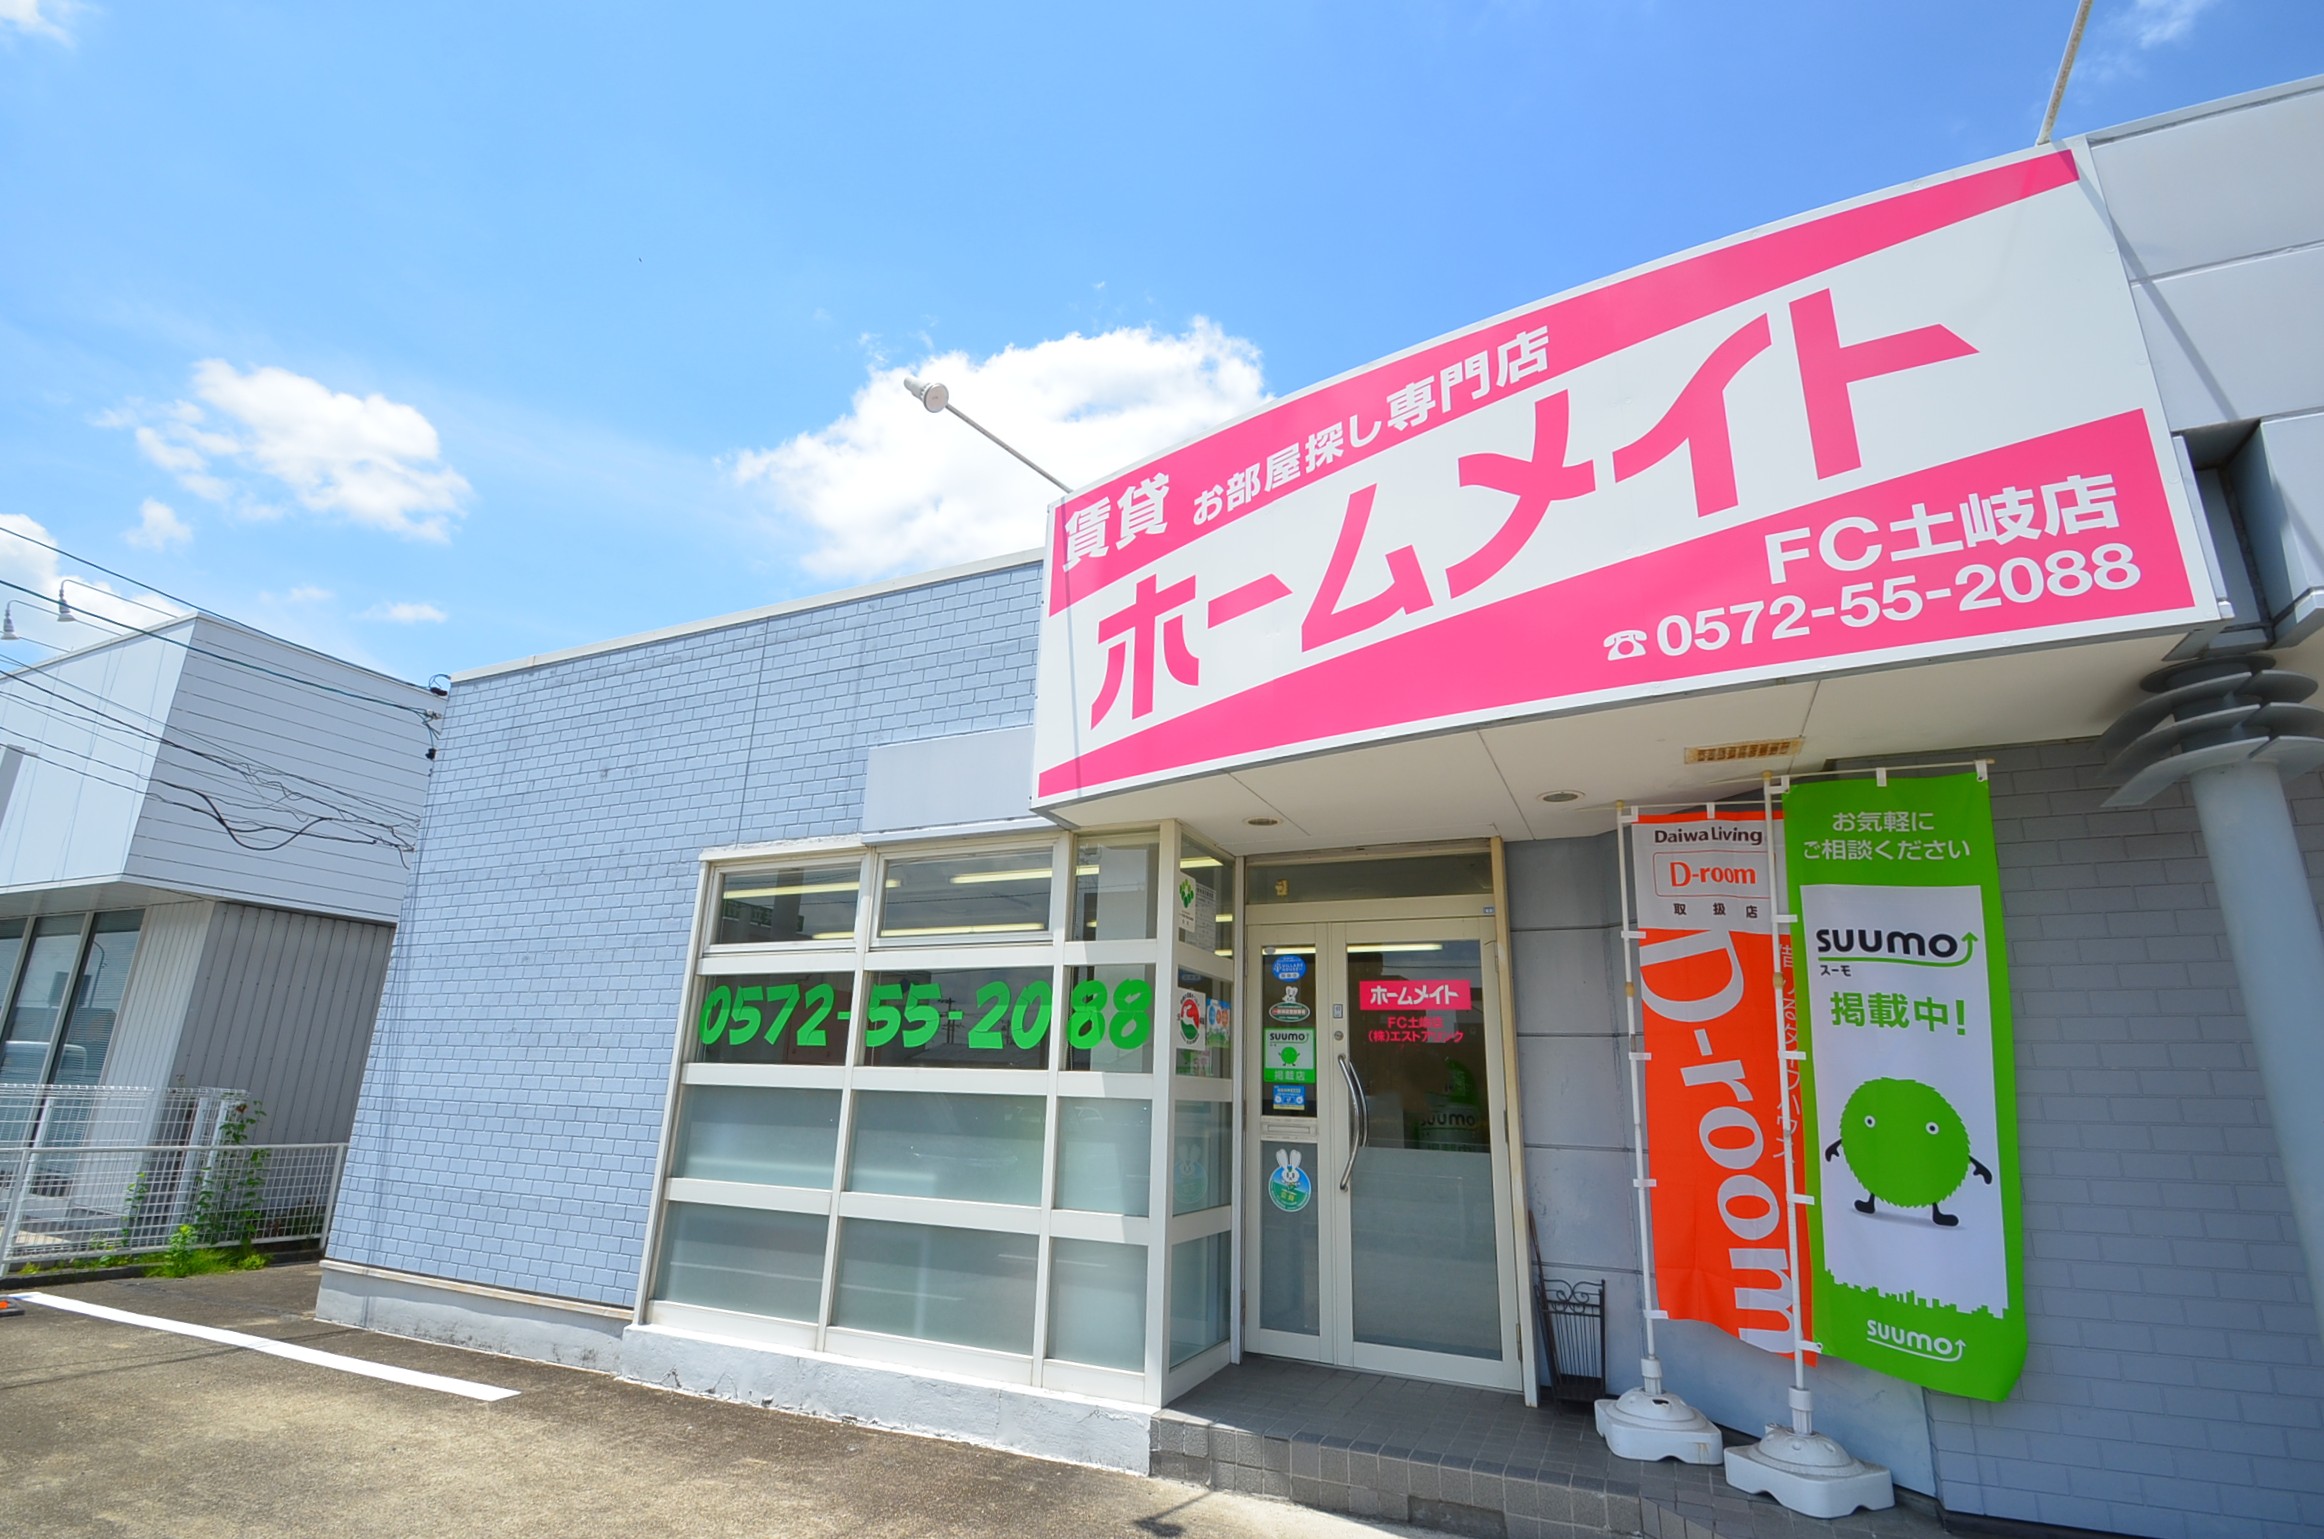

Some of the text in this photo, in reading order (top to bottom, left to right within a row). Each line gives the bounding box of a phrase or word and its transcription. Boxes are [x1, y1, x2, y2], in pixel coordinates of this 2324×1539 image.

[1062, 325, 1549, 573] 賃貸 お部屋探し専門店
[1090, 287, 1980, 730] ホームメイト
[1764, 473, 2121, 584] FC土岐店
[1656, 542, 2141, 657] 0572-55-2088
[1803, 839, 1971, 861] ご相談ください
[1832, 811, 1935, 833] お気軽に
[1669, 861, 1757, 888] D-room
[1370, 985, 1460, 1005] ホームメイト
[1819, 965, 1852, 977] スーモ
[700, 978, 1152, 1050] 0572-55-2088
[1830, 991, 1966, 1036] 掲載中!
[1639, 930, 1796, 1354] D-room
